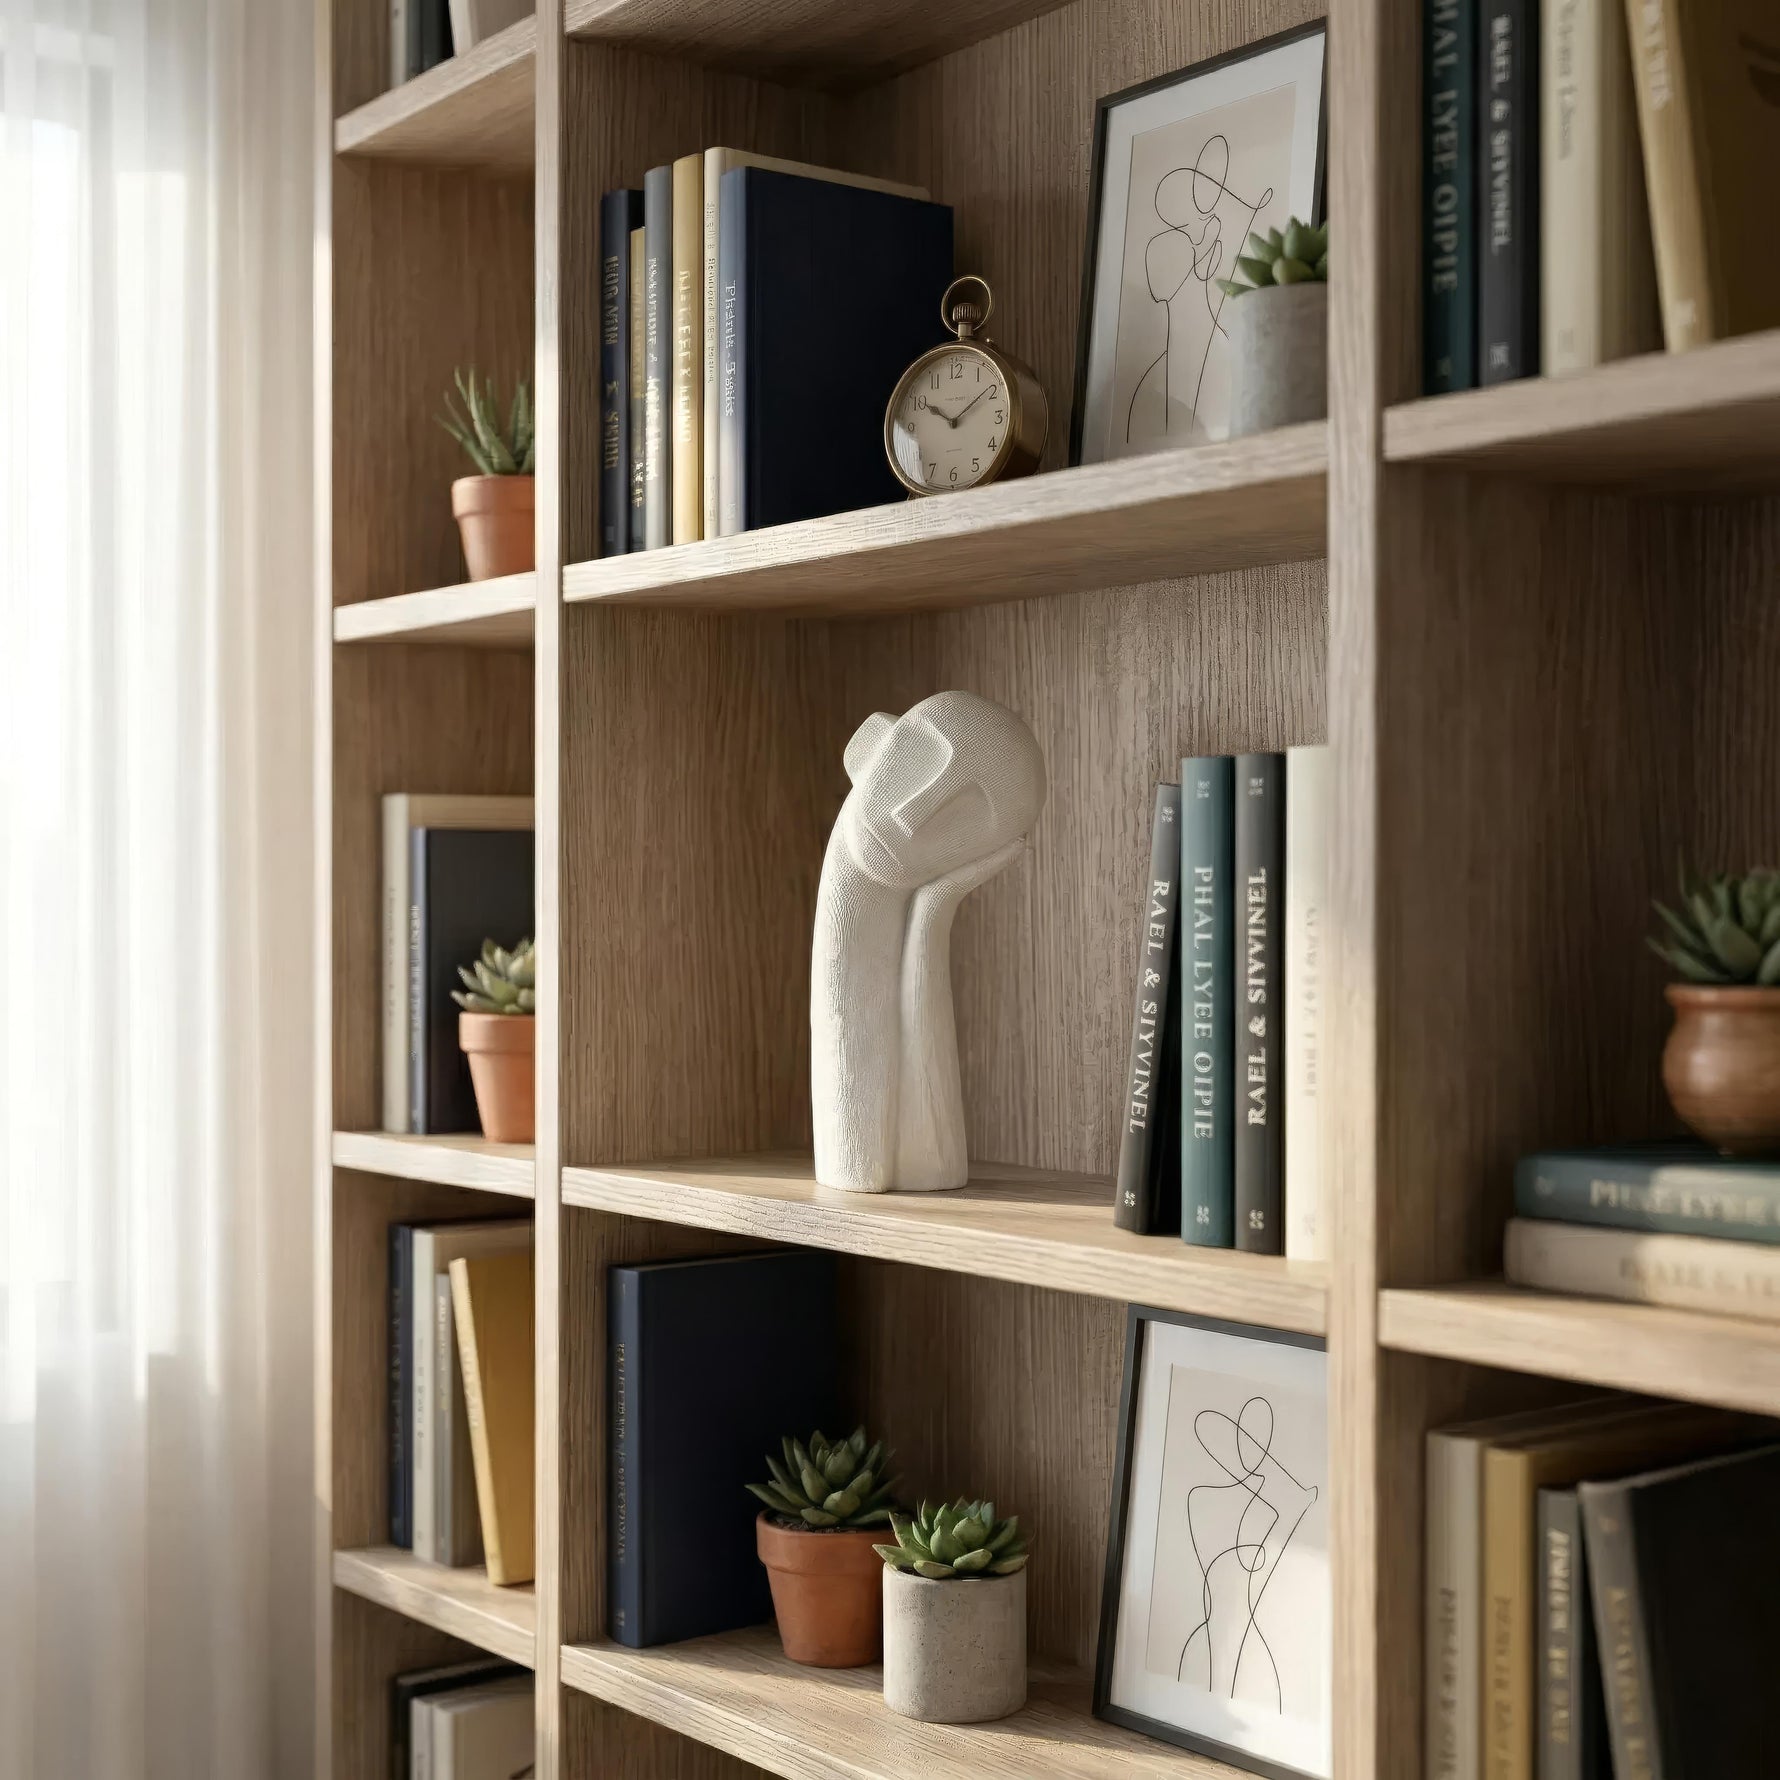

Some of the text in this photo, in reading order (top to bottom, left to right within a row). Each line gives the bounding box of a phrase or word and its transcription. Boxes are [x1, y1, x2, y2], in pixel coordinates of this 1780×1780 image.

[949, 363, 963, 380] 12
[976, 367, 980, 382] 1
[988, 384, 997, 400] 2
[913, 395, 927, 411] 10
[994, 410, 1003, 425] 3
[987, 436, 997, 452] 4
[929, 463, 937, 479] 7
[971, 458, 980, 472] 5
[949, 466, 958, 482] 6
[1194, 867, 1213, 949] PHAL
[1147, 879, 1170, 955] RAEL
[1143, 967, 1160, 988] &
[1247, 1047, 1266, 1126] RAEL
[1194, 1051, 1214, 1139] OIPIE
